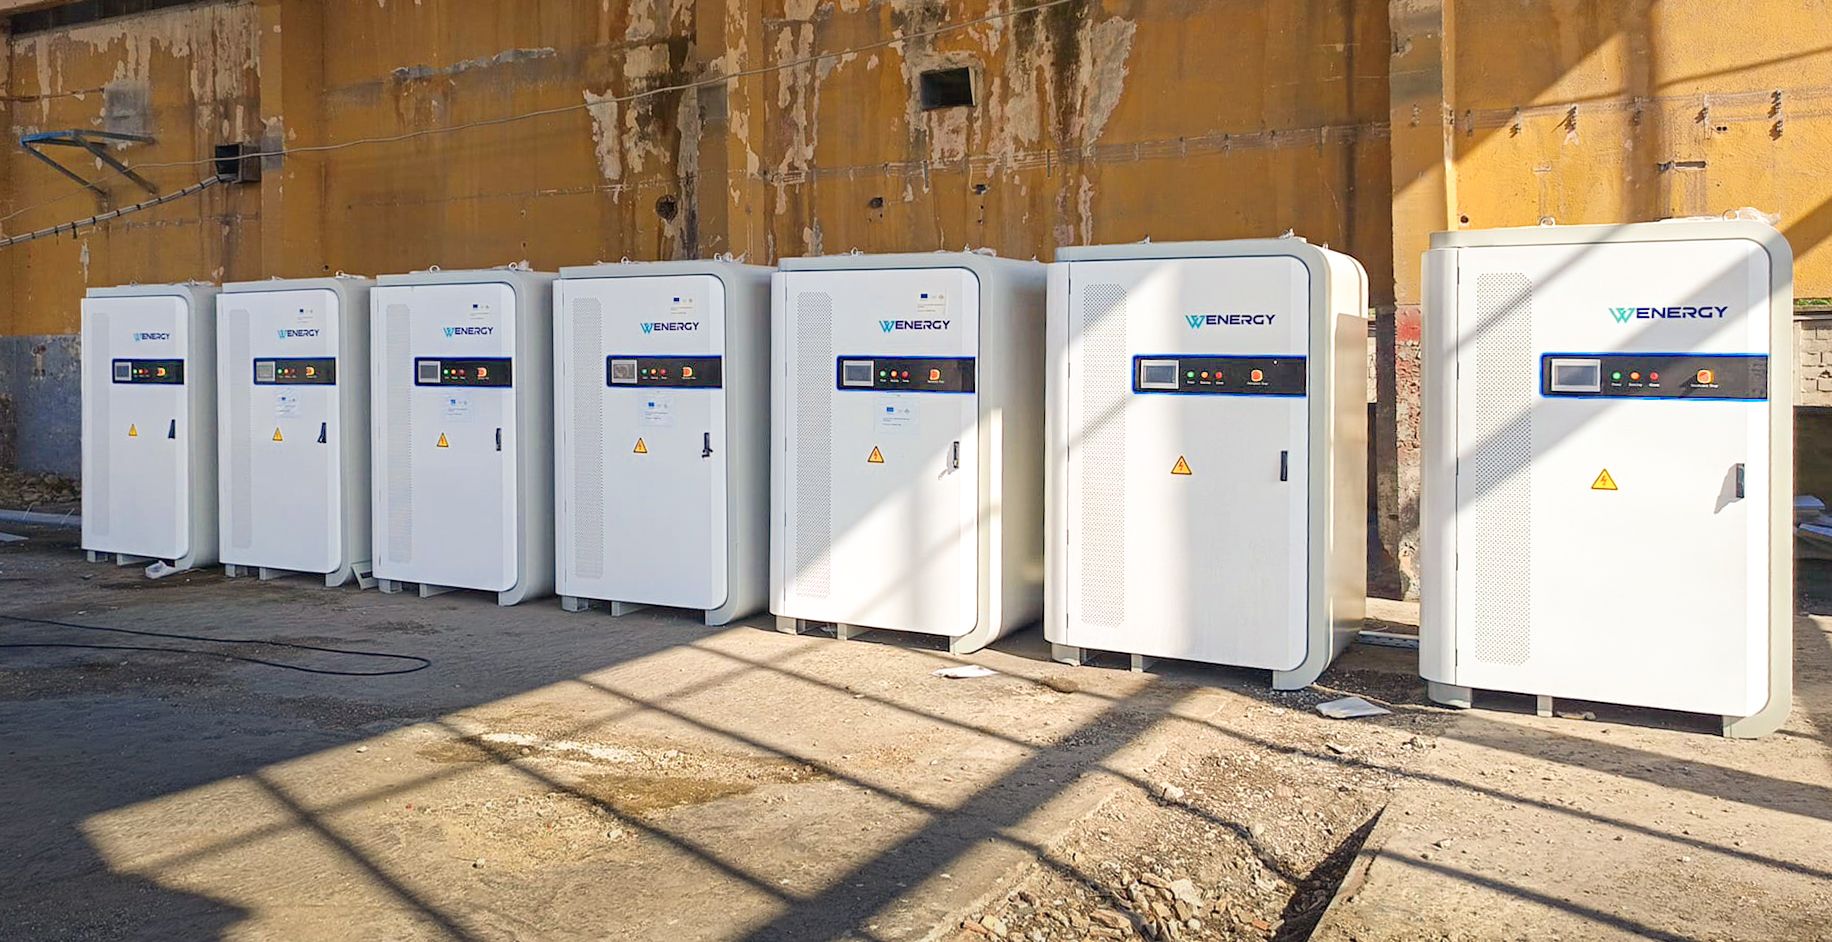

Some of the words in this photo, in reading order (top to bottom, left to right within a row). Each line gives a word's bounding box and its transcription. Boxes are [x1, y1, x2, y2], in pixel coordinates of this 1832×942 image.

[1185, 314, 1276, 329] WENERGY
[1608, 306, 1729, 324] WENERGY
[443, 327, 494, 337] WENERGY
[640, 322, 700, 334] WENERGY
[879, 320, 951, 333] WENERGY
